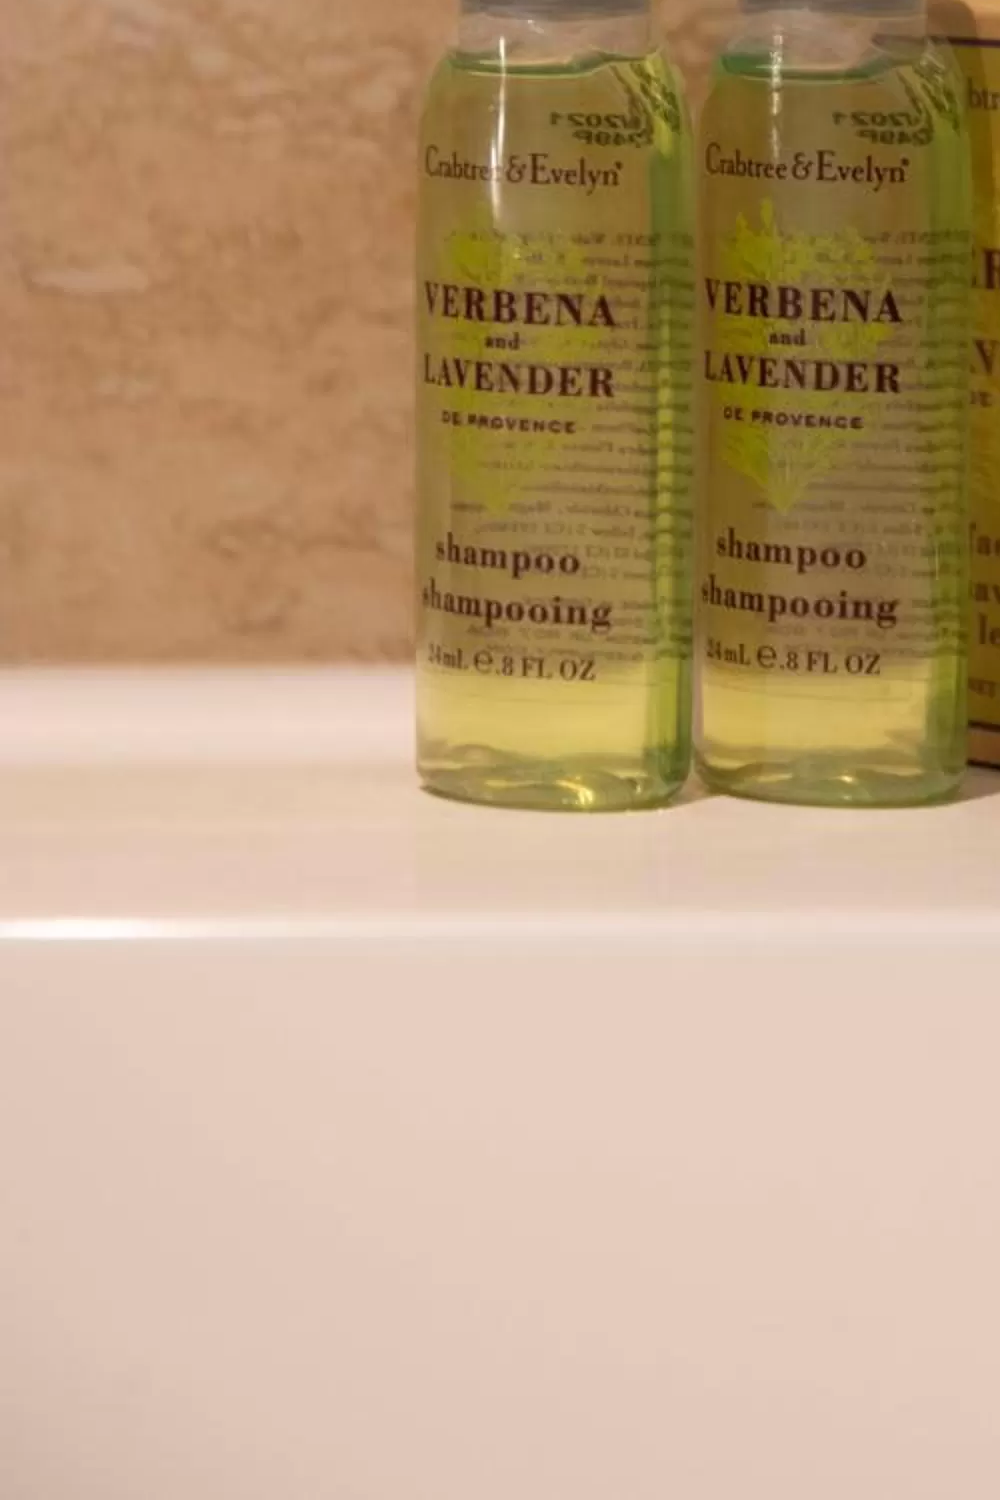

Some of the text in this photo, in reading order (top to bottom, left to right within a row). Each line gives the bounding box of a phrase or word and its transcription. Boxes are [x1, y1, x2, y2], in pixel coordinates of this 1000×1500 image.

[425, 144, 502, 181] Crabtre
[529, 153, 619, 196] Evelyn
[705, 142, 788, 180] Crabtree
[816, 150, 905, 192] Evelyn
[425, 281, 616, 327] VERBENA
[704, 278, 903, 323] VERBENA
[484, 333, 520, 351] and
[768, 328, 807, 347] and
[424, 353, 615, 398] LAVENDER
[704, 350, 901, 394] LAVENDER
[441, 411, 462, 426] DE
[467, 414, 577, 434] PROVENCE
[723, 406, 864, 430] DE PROVENCE
[435, 533, 581, 580] shampoo
[715, 528, 867, 574] shampoo
[422, 577, 613, 635] shampooing
[702, 574, 899, 628] shampooing
[559, 657, 597, 682] OZ
[844, 653, 881, 675] OZ
